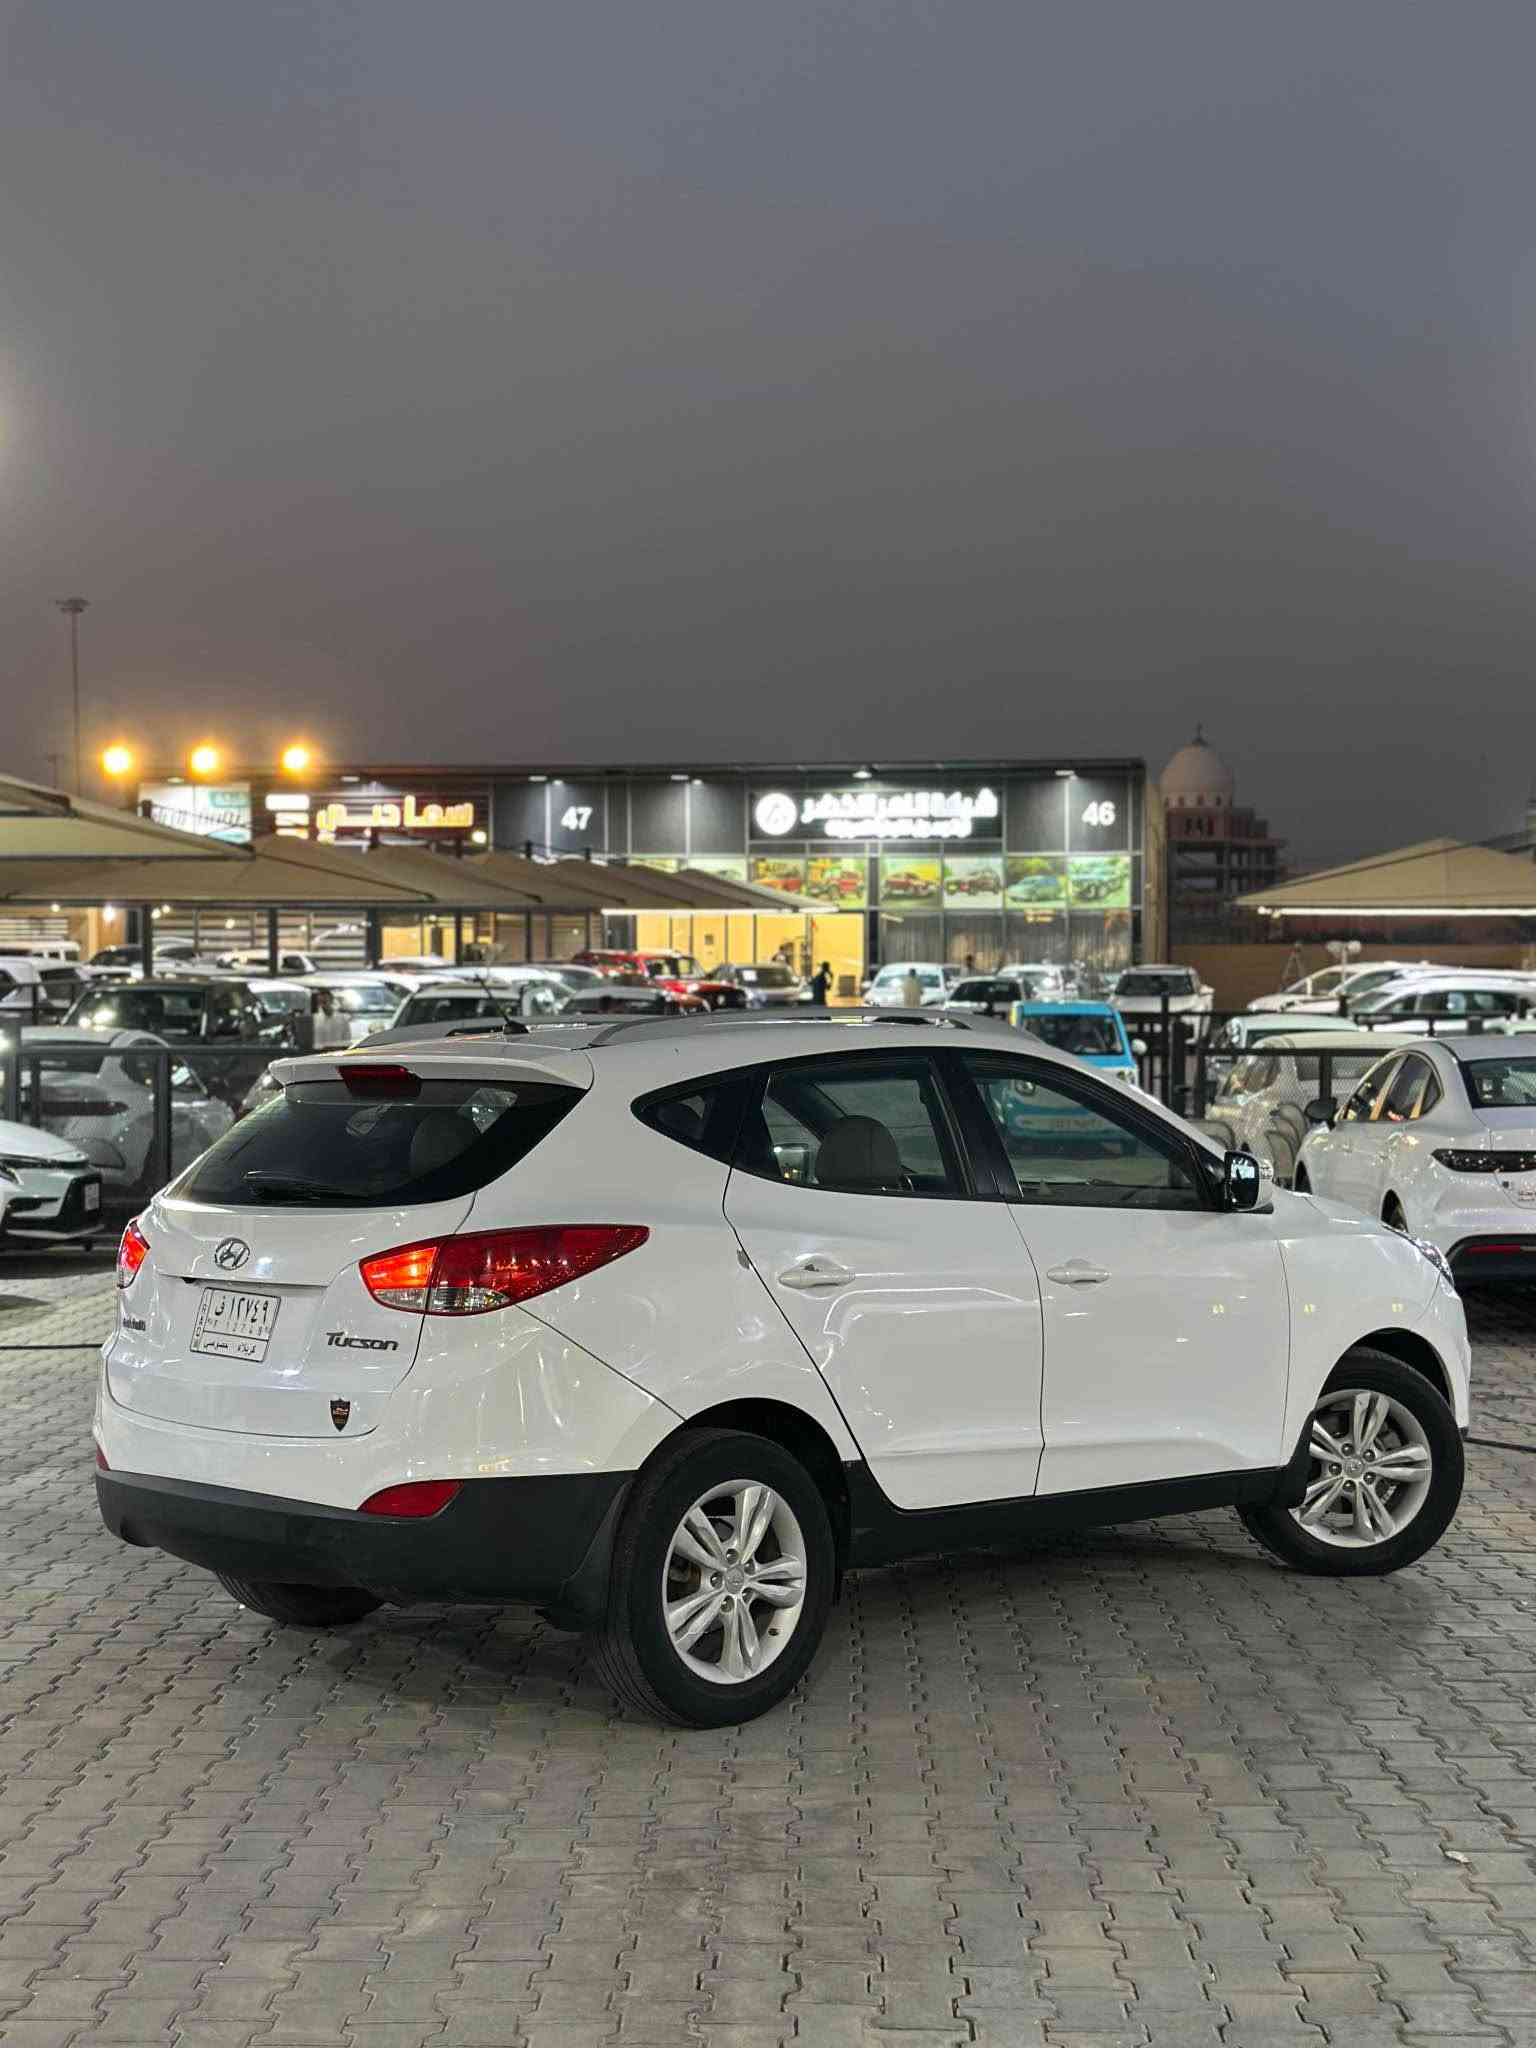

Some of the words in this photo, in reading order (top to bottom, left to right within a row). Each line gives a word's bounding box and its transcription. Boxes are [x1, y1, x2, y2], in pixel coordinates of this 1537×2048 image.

[560, 805, 593, 831] 47
[1081, 800, 1116, 827] 46
[326, 1331, 399, 1351] Tucson
